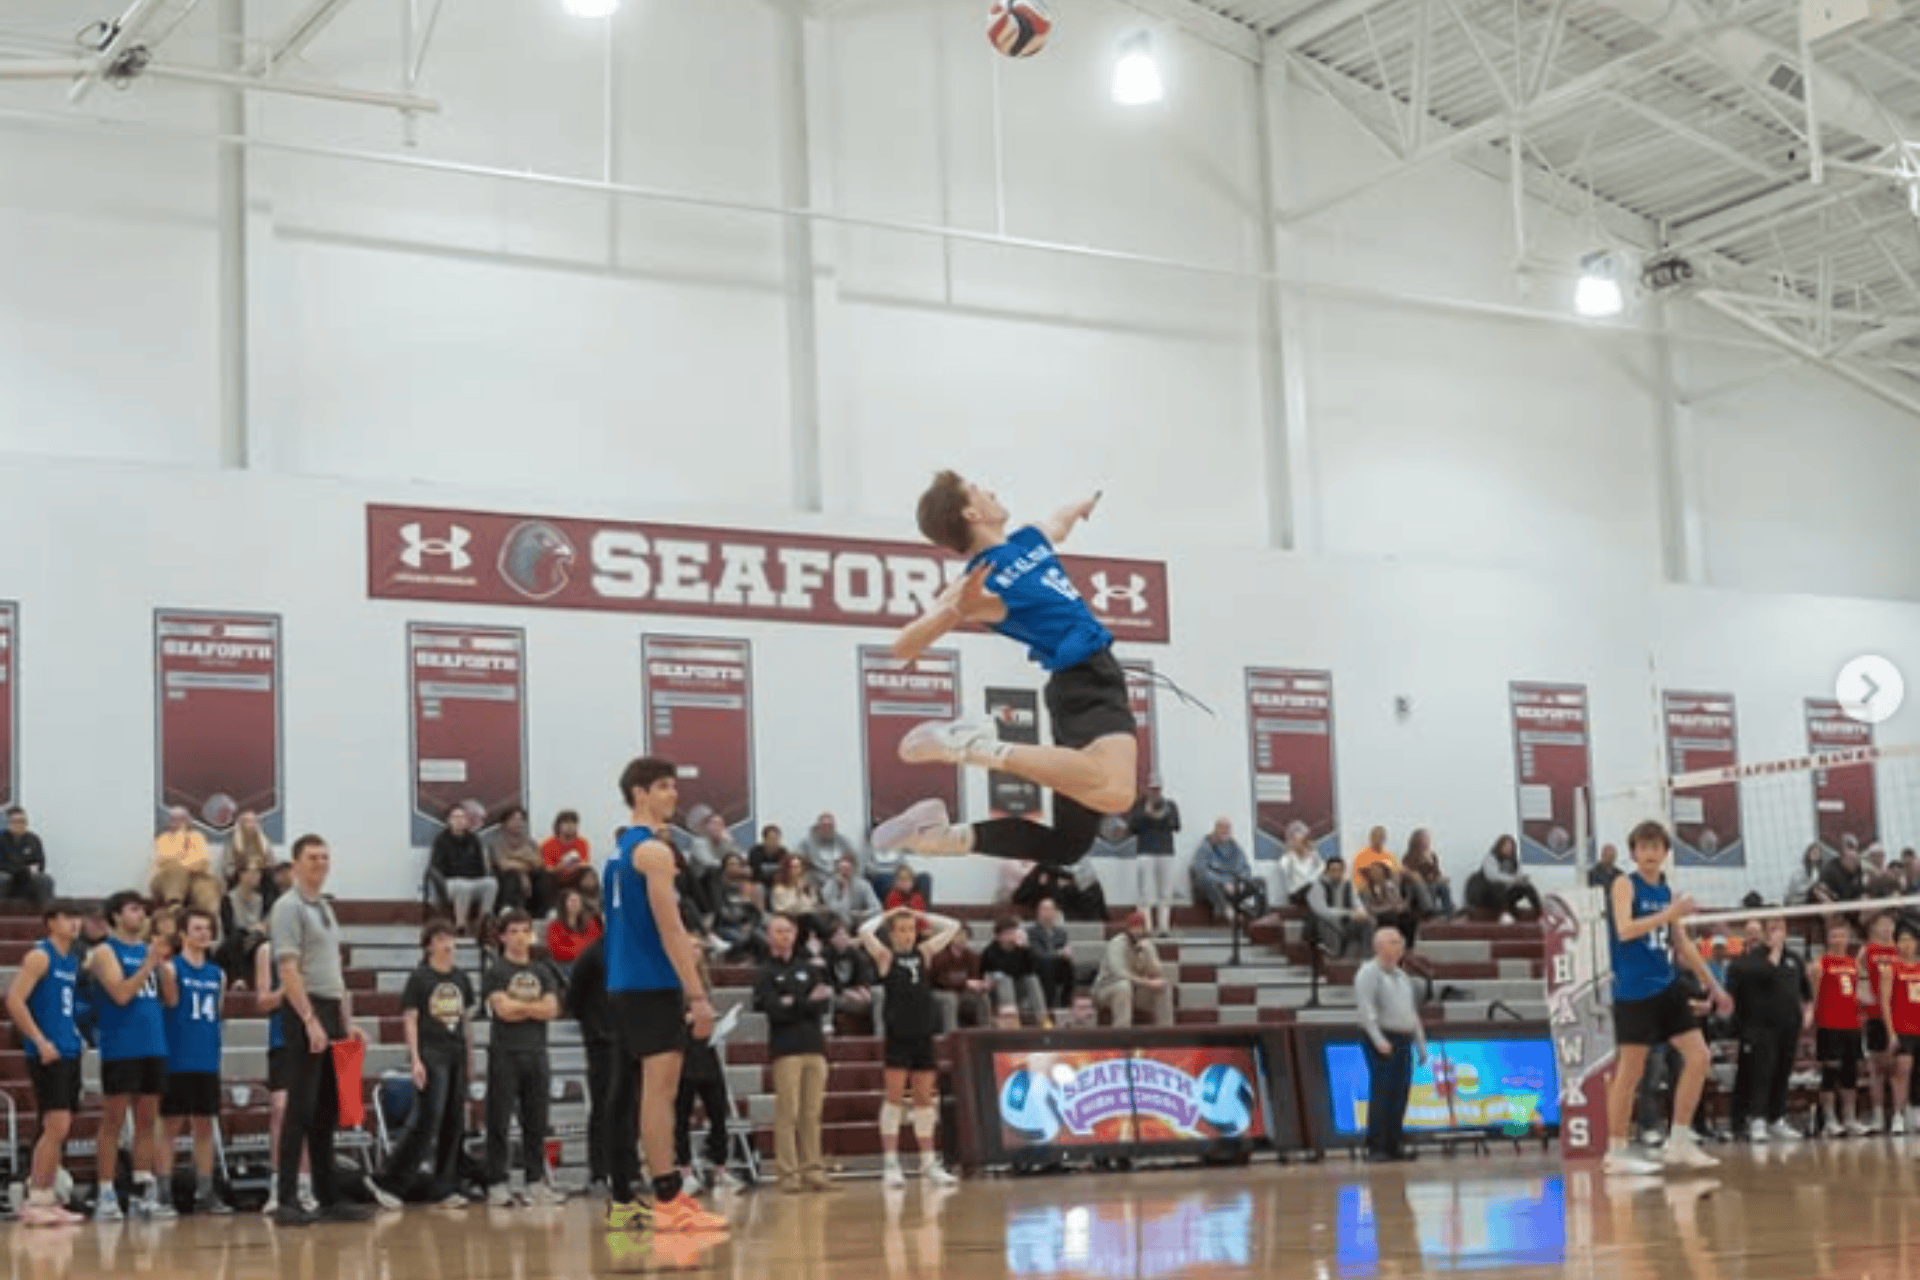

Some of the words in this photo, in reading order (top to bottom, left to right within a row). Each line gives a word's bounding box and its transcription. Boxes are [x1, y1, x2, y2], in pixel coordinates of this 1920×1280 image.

[591, 529, 968, 616] SEAFOR
[192, 991, 215, 1023] 14
[1063, 1063, 1193, 1099] SEAFORTH
[1551, 954, 1589, 1147] HAWKS
